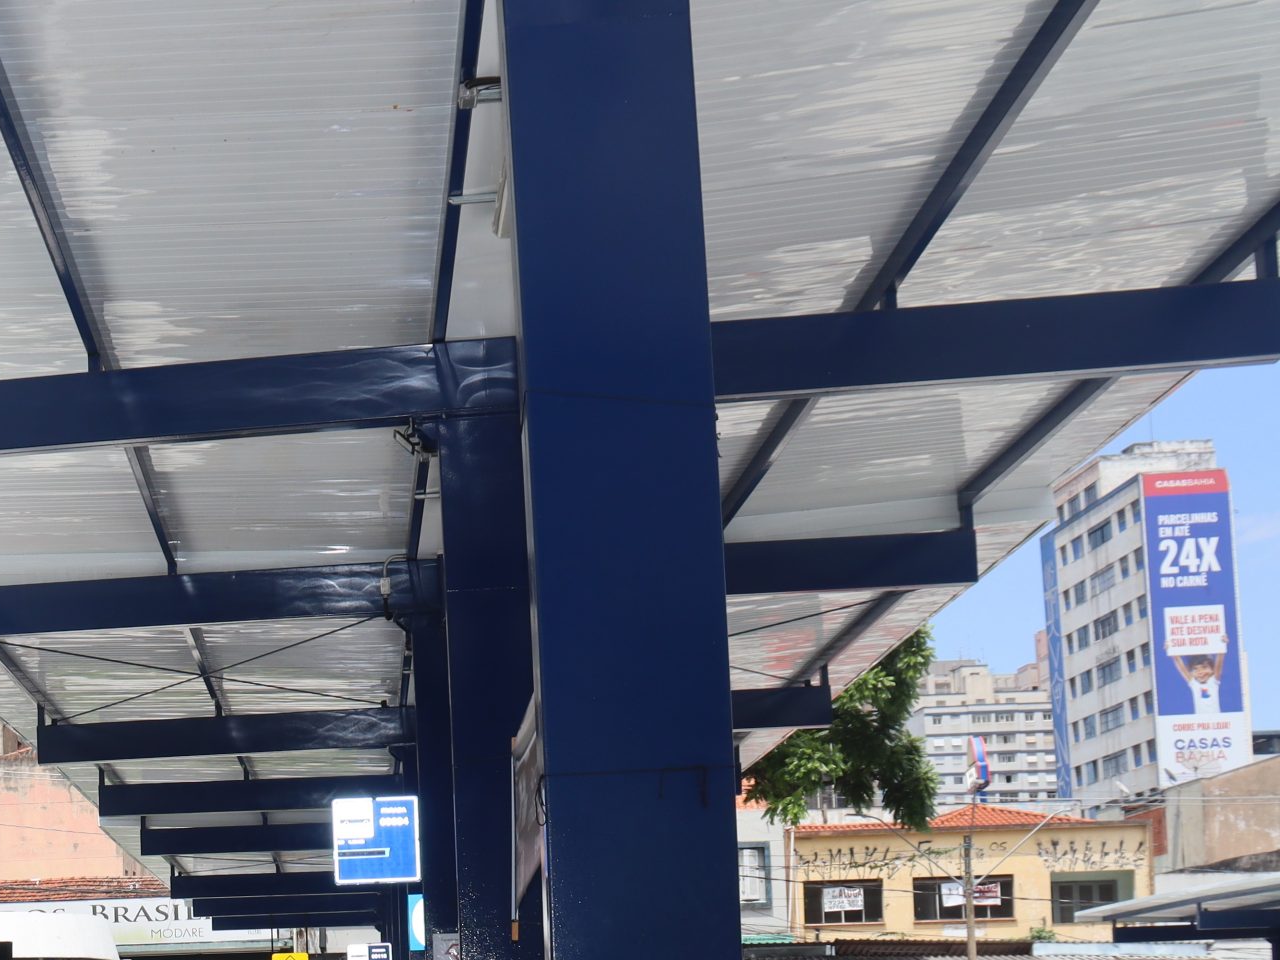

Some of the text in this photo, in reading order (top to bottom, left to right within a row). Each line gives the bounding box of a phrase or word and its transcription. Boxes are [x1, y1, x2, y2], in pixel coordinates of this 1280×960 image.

[1157, 512, 1219, 525] PARCELINHAS
[1158, 523, 1191, 538] EM ATÉ
[1158, 537, 1222, 575] 24X
[1160, 572, 1208, 588] NO CARNÊ
[1169, 615, 1190, 625] VALE
[1198, 613, 1219, 623] PENA
[1187, 625, 1220, 635] DESVIAR
[1171, 637, 1209, 648] SUA ROTA
[1174, 737, 1232, 750] CASAS
[1175, 750, 1227, 763] BAHIA
[150, 927, 205, 939] MODARE
